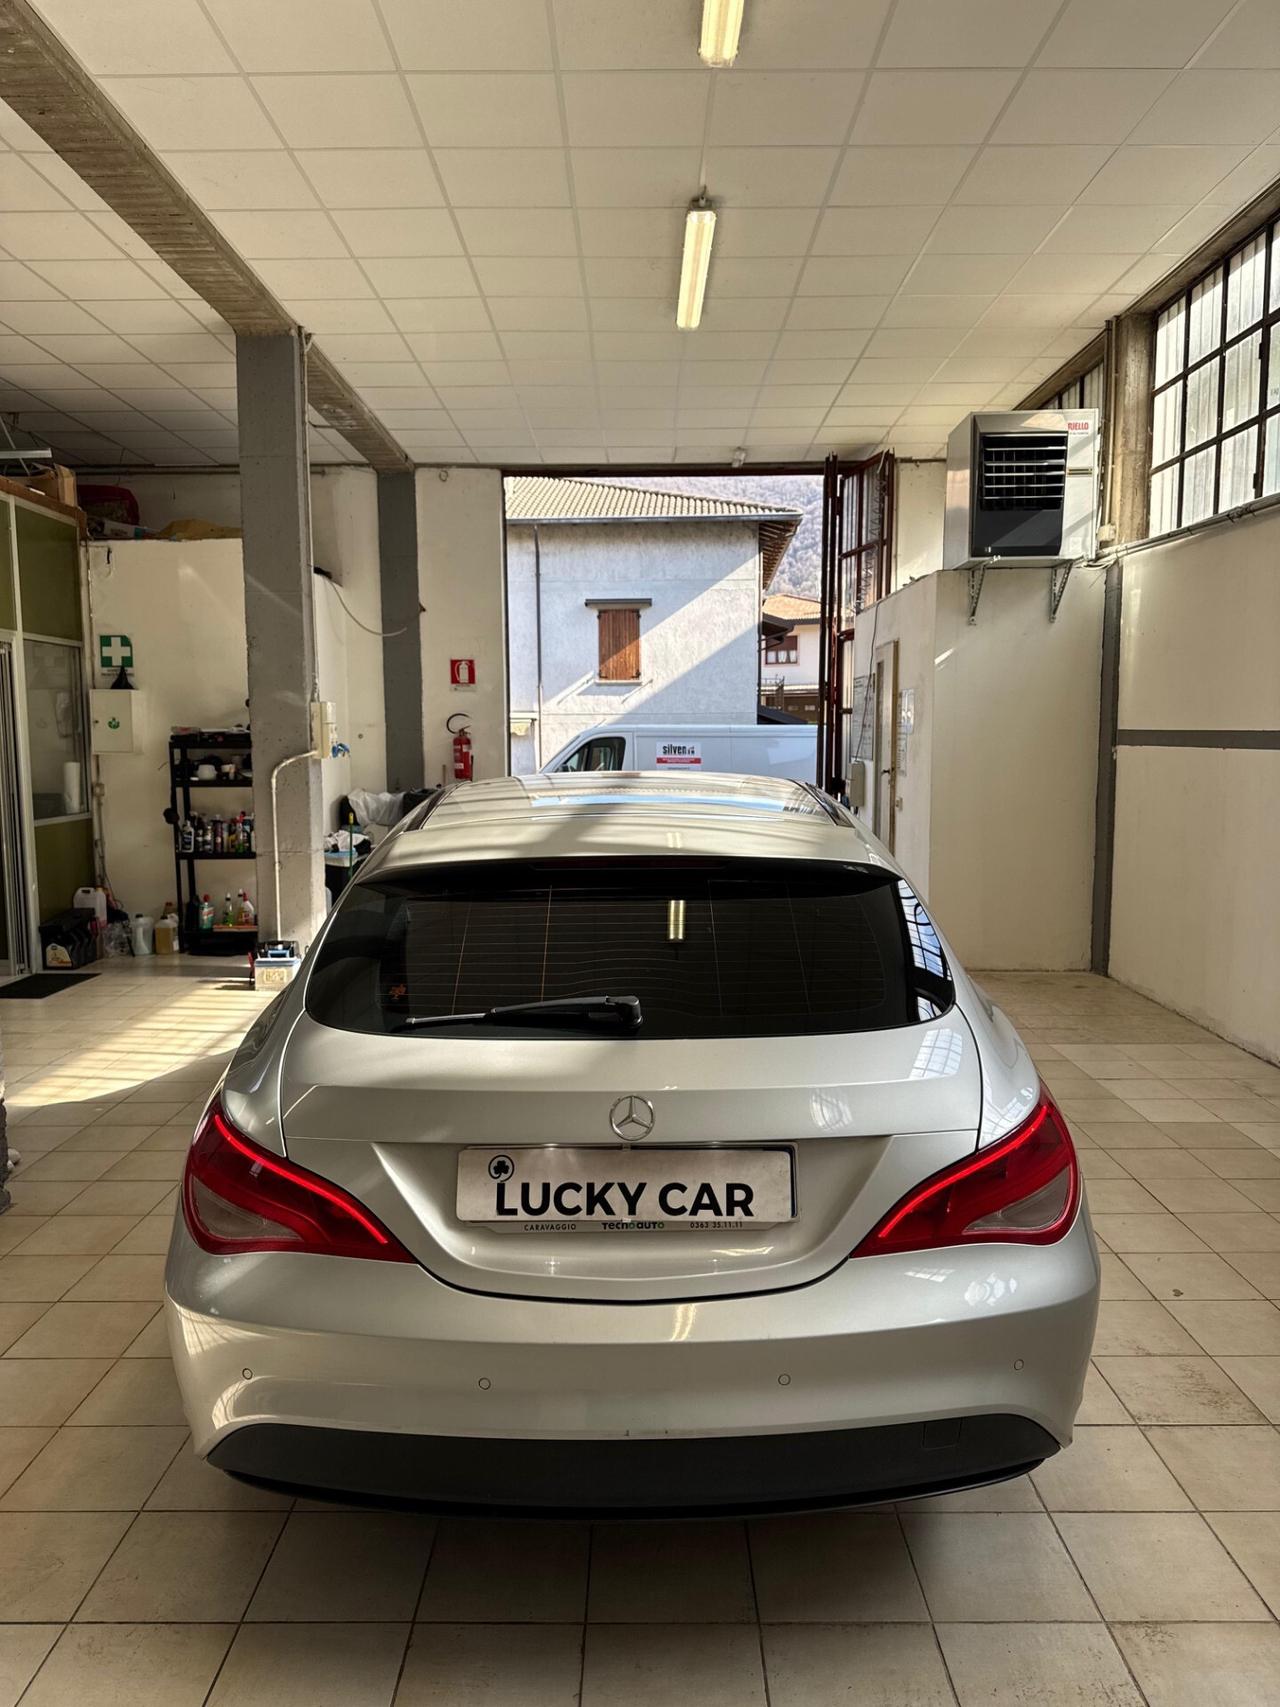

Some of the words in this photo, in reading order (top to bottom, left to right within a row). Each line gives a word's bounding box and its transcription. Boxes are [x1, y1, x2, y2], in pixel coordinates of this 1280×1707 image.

[496, 1182, 647, 1216] LUCKY
[658, 1182, 754, 1217] CAR
[524, 1223, 576, 1231] CARAVAGGIO
